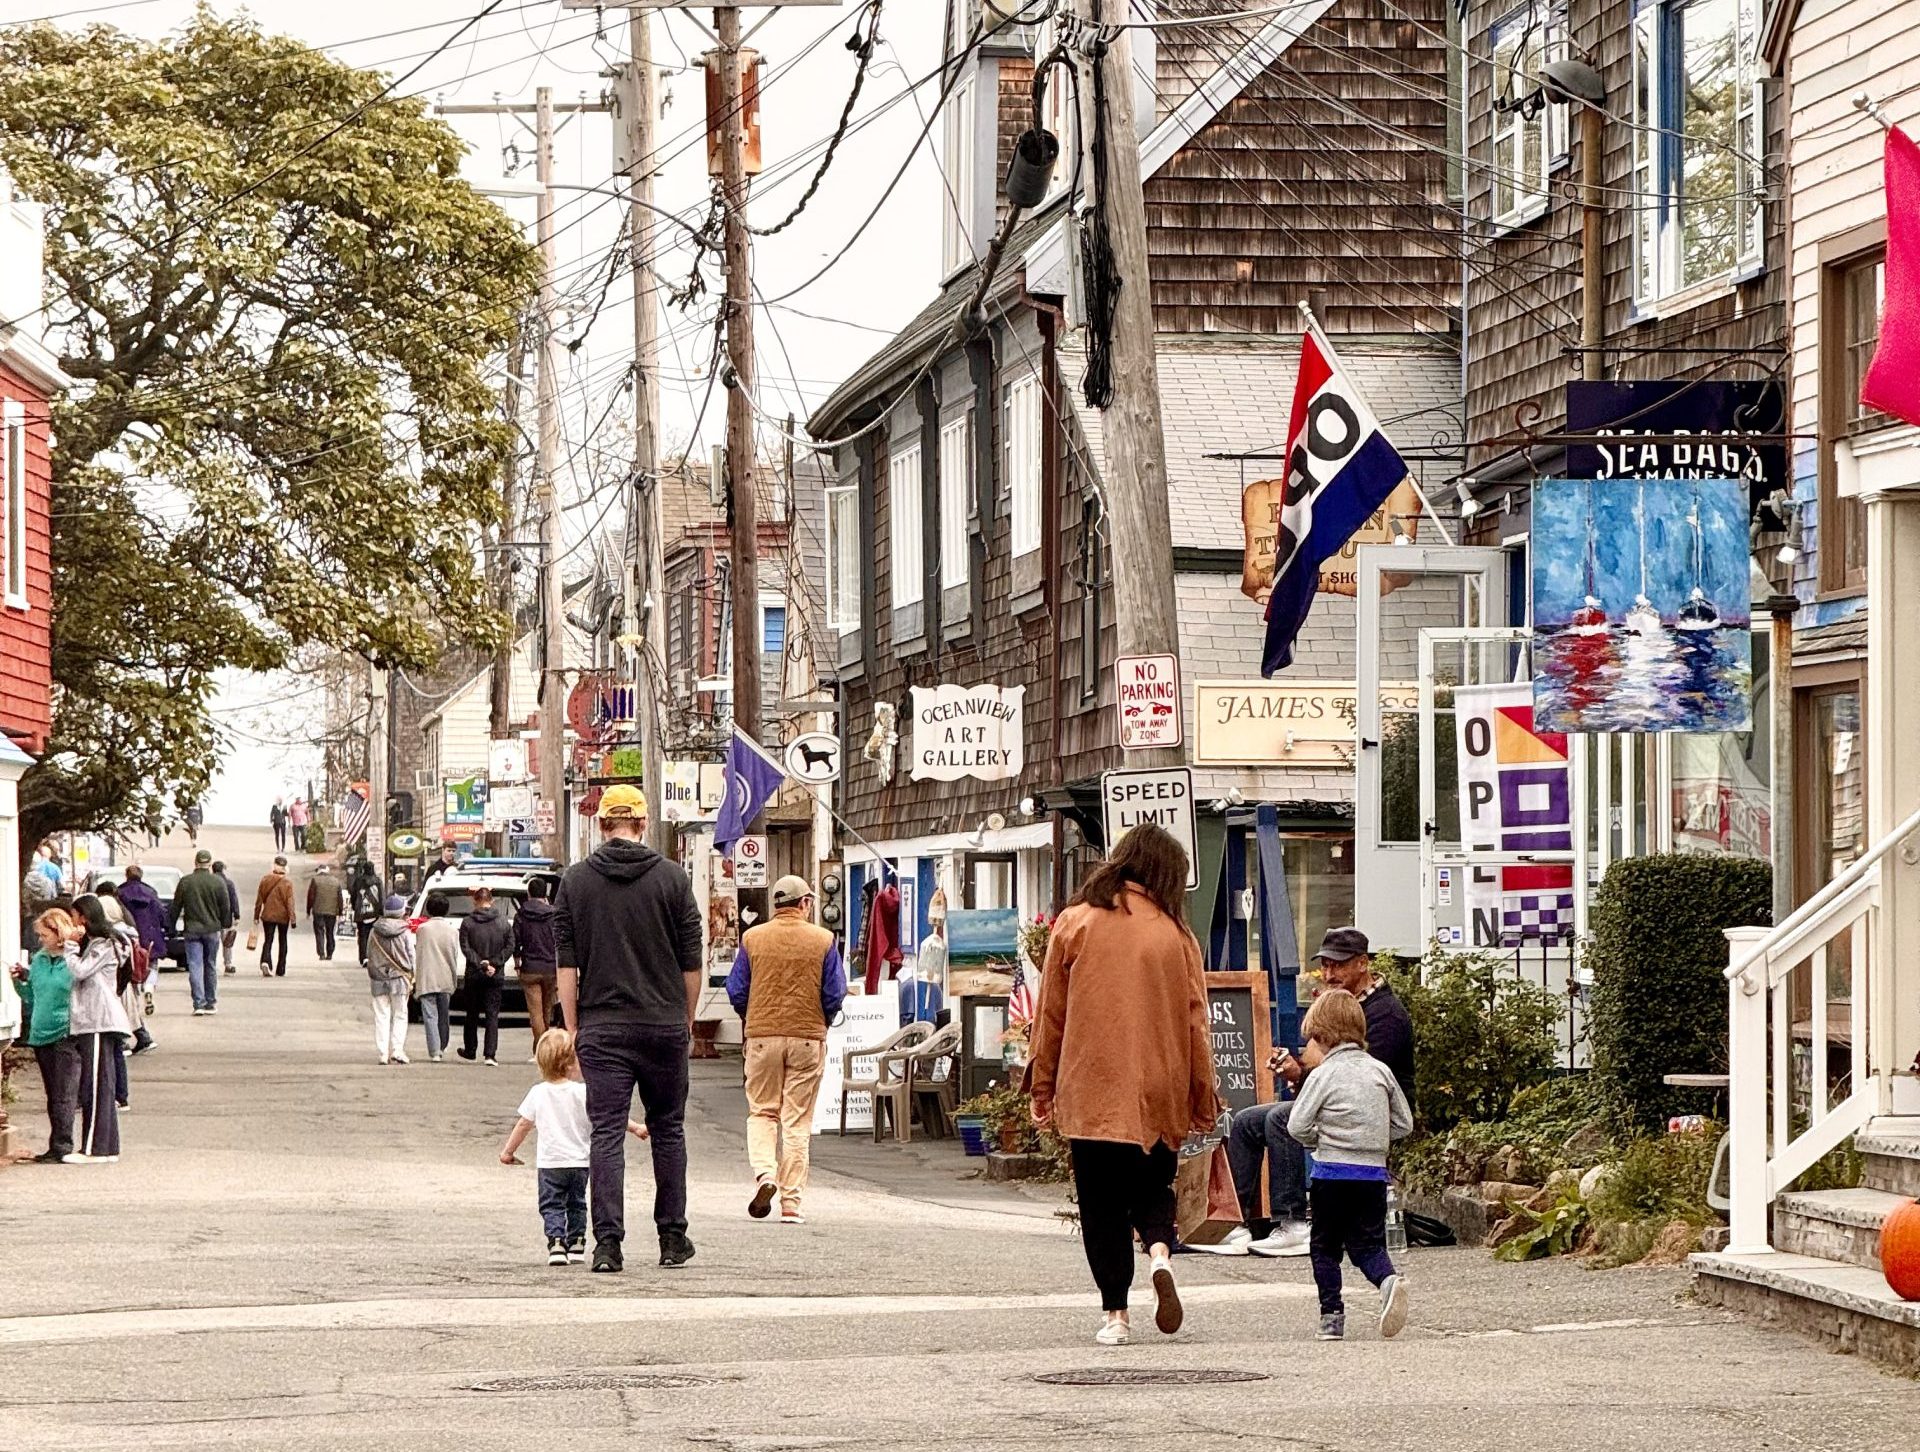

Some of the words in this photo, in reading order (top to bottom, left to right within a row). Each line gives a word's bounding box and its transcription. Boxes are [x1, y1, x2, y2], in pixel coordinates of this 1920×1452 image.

[1596, 429, 1659, 481] SEA
[1646, 467, 1715, 480] MAINE
[1135, 663, 1157, 681] NO
[1122, 681, 1174, 701] PARKING
[921, 697, 1017, 725] OCEANVIEW
[1216, 696, 1324, 725] JAMES
[1130, 719, 1146, 730] TOW
[1149, 718, 1168, 729] AWAY
[944, 726, 987, 744] ART
[1139, 730, 1161, 740] ZONE
[922, 749, 1012, 767] GALLERY
[665, 782, 691, 800] Blue
[1111, 781, 1186, 803] SPEED
[580, 802, 598, 812] 546
[1120, 808, 1179, 828] LIMIT
[1209, 1031, 1245, 1049] TOTES
[1213, 1053, 1252, 1069] SORIES
[1227, 1072, 1255, 1090] SAILS
